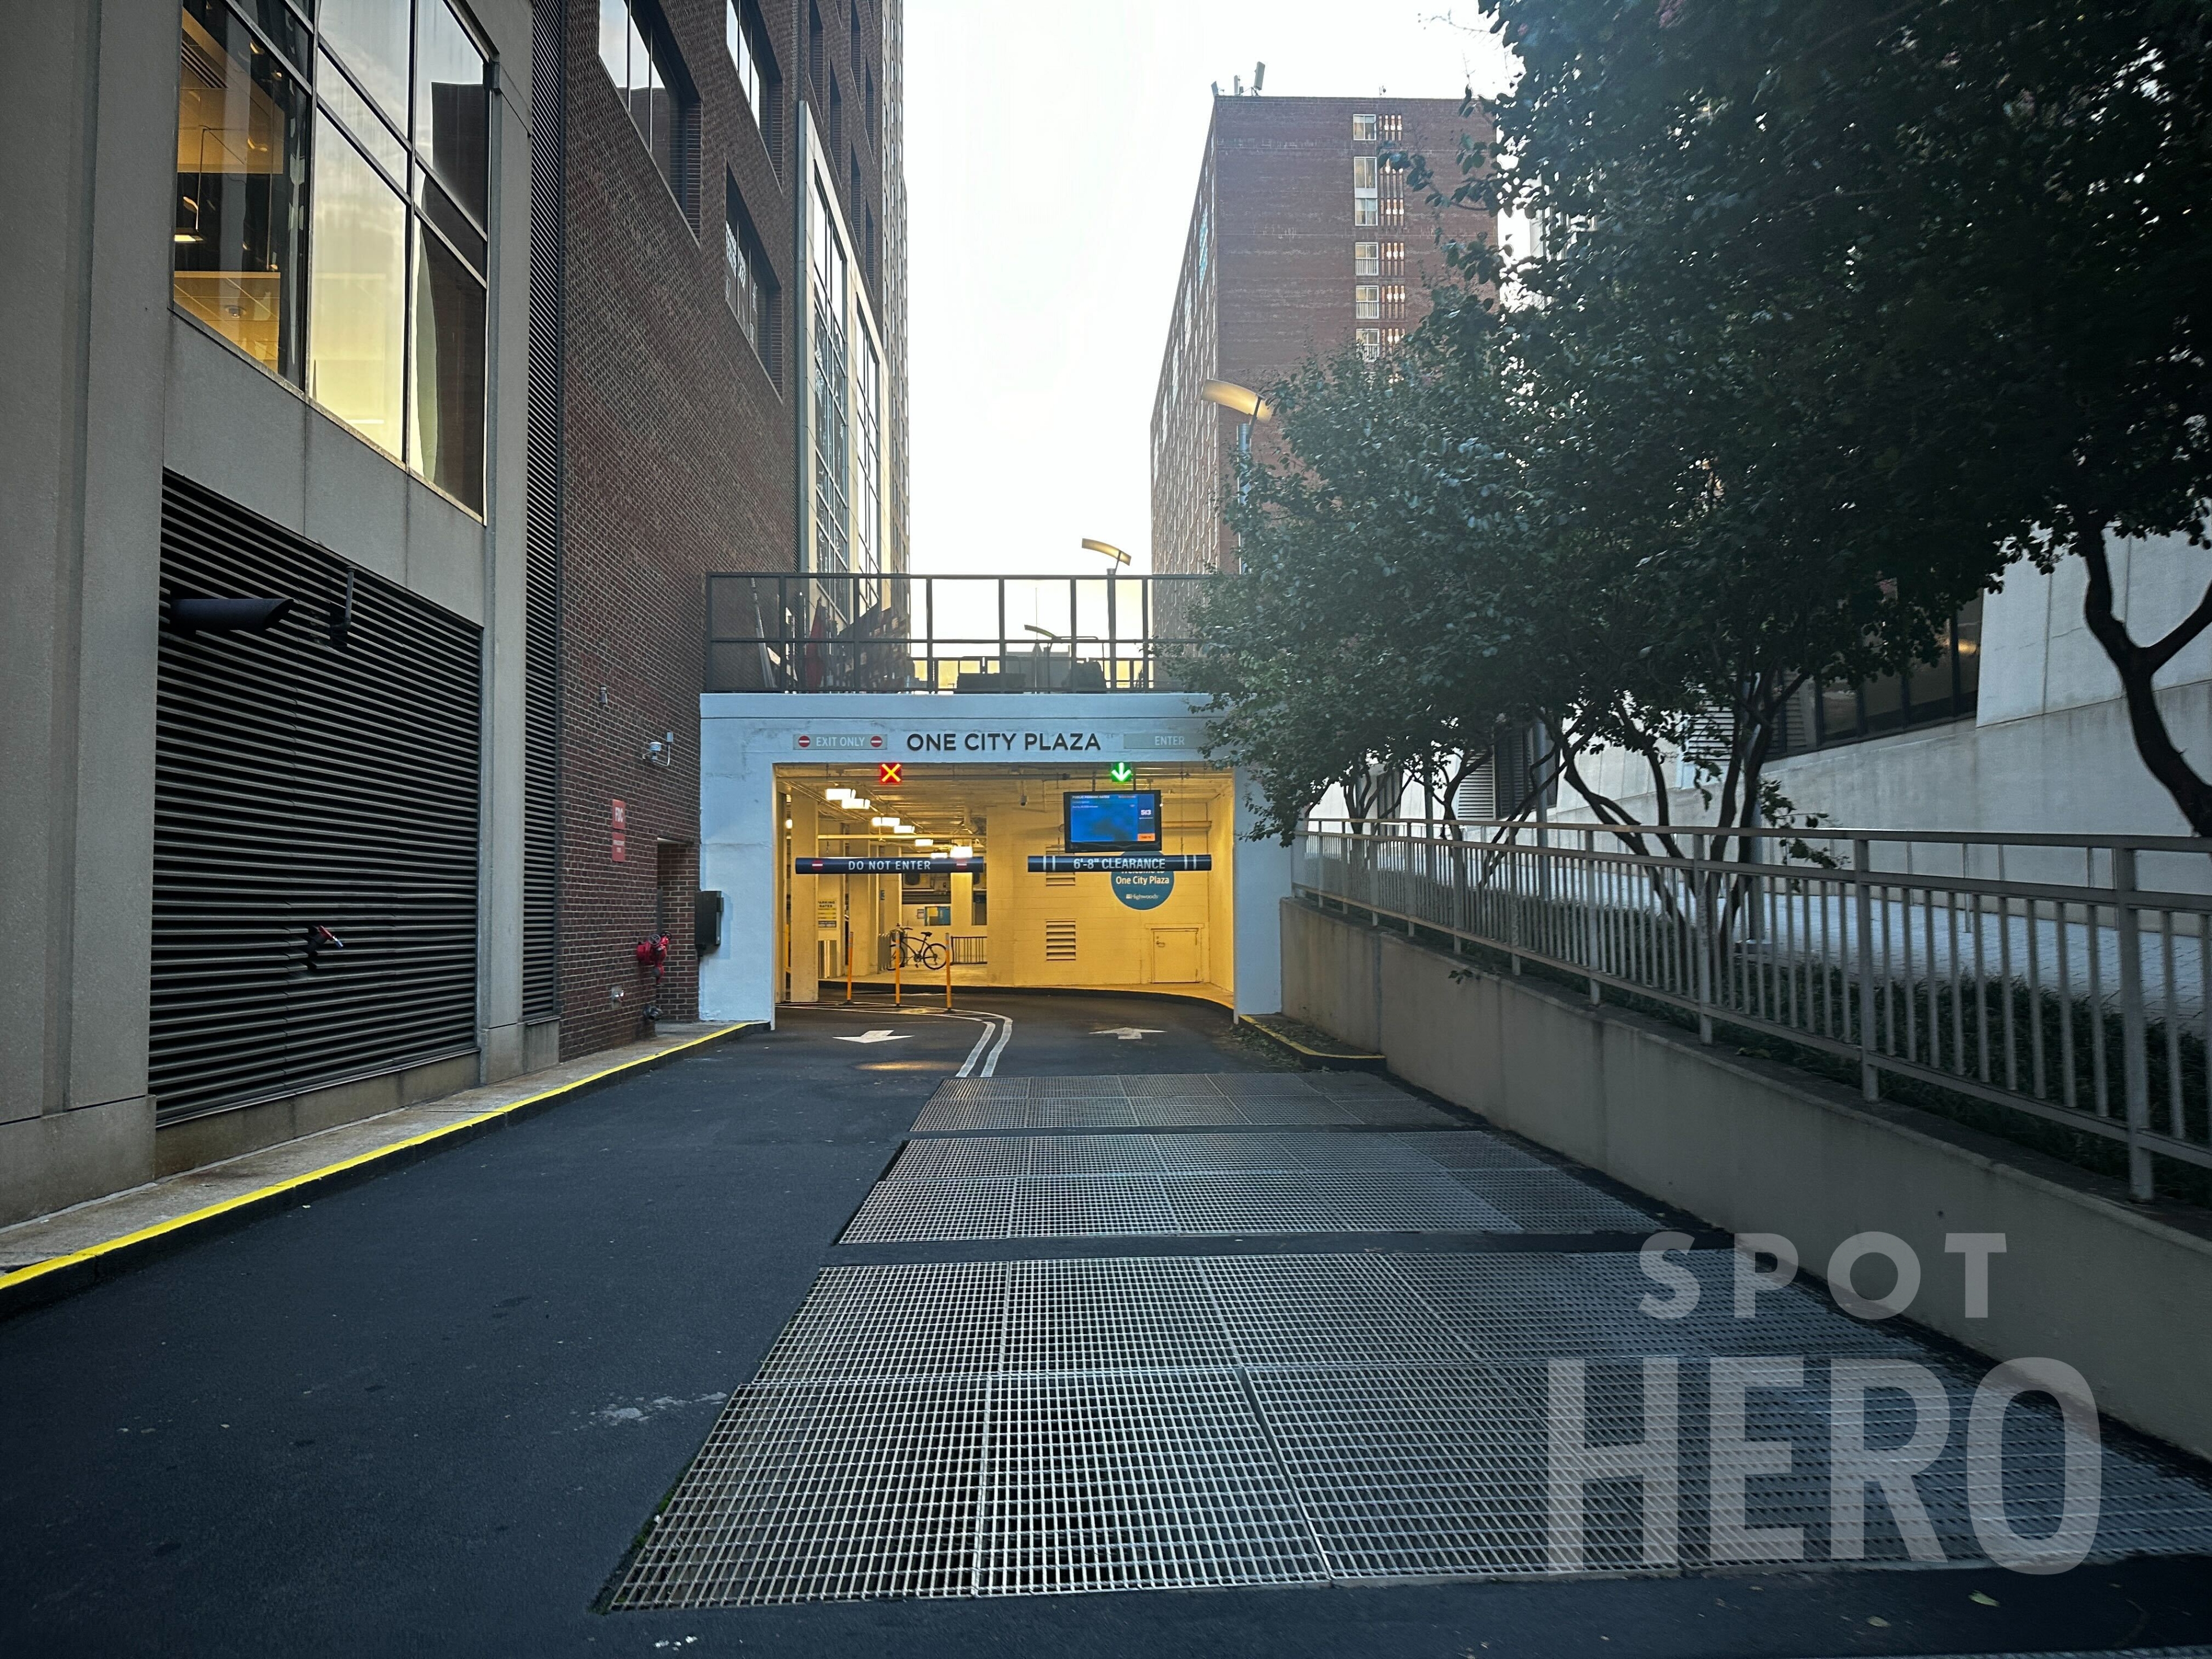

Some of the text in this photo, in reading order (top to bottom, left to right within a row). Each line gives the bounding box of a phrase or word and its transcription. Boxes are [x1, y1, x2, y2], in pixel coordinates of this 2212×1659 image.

[816, 737, 865, 747] EXIT ONLY
[907, 733, 1101, 751] ONE CITY PLAZA
[1154, 736, 1185, 745] ENTER
[848, 861, 931, 870] DO NOT ENTER
[1101, 858, 1166, 869] CLEARANCE
[1116, 876, 1170, 885] One City Plaza
